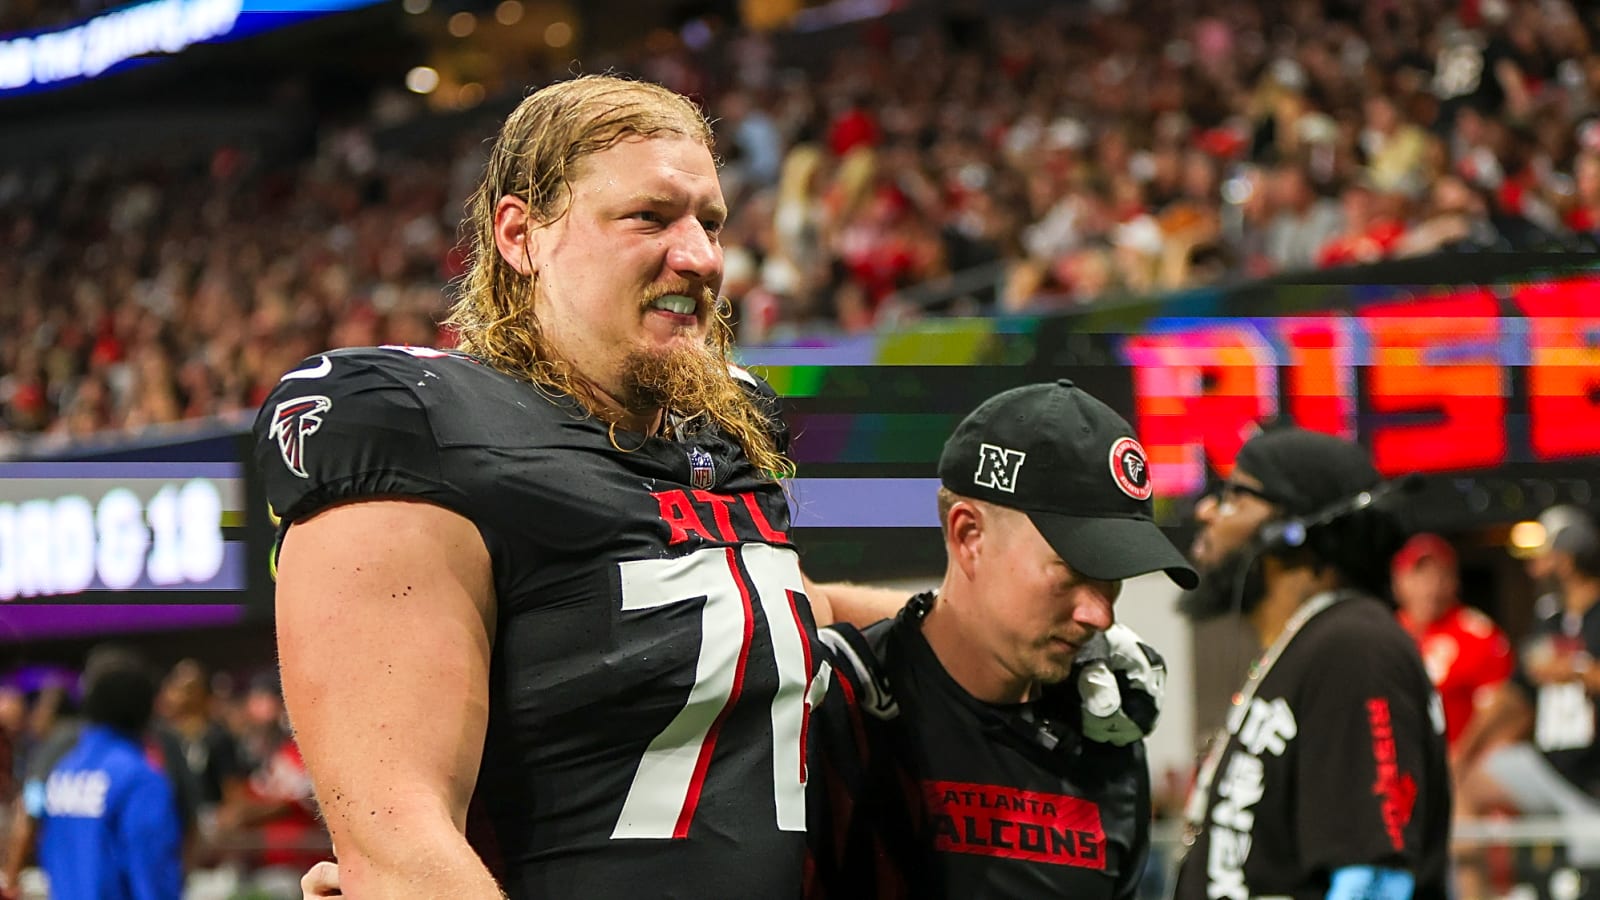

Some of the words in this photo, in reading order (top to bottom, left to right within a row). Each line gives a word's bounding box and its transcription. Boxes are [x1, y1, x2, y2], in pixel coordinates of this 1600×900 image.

[694, 469, 712, 487] NFL
[974, 443, 1027, 494] N
[650, 489, 788, 545] ATL
[943, 789, 1058, 818] ATLANTA
[930, 814, 1099, 861] ALCONS
